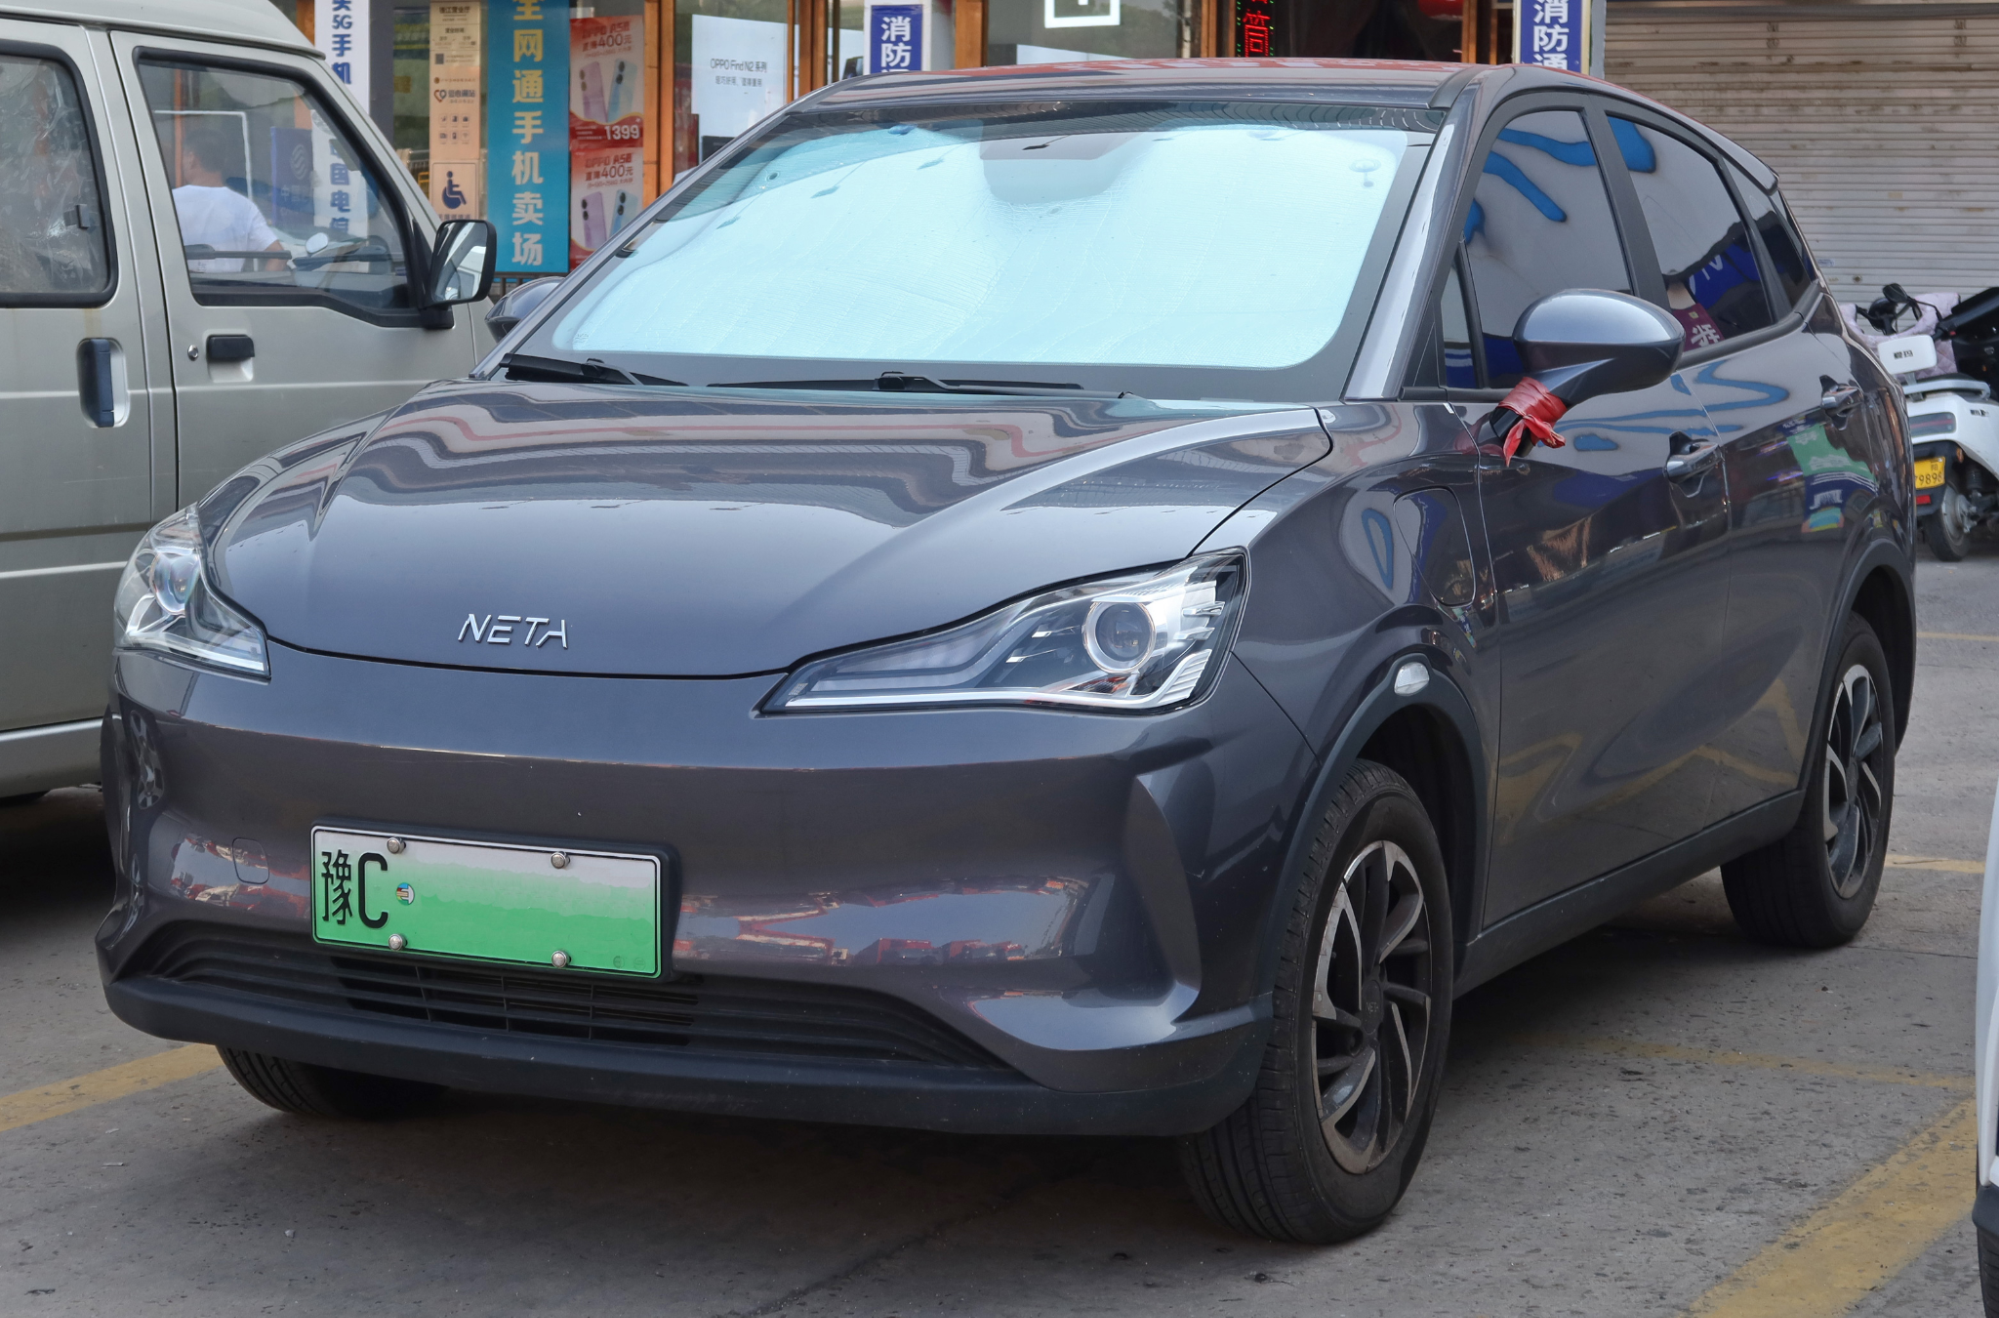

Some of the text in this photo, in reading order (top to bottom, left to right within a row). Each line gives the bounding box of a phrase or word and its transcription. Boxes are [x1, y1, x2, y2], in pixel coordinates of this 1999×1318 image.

[710, 57, 730, 70] OPPO
[730, 59, 744, 71] Find
[744, 60, 754, 72] N2
[881, 15, 912, 73] 消防
[512, 0, 544, 266] 全网通手机卖场
[604, 124, 640, 140] 1399
[458, 613, 568, 649] NETA
[321, 849, 389, 929] 豫C
